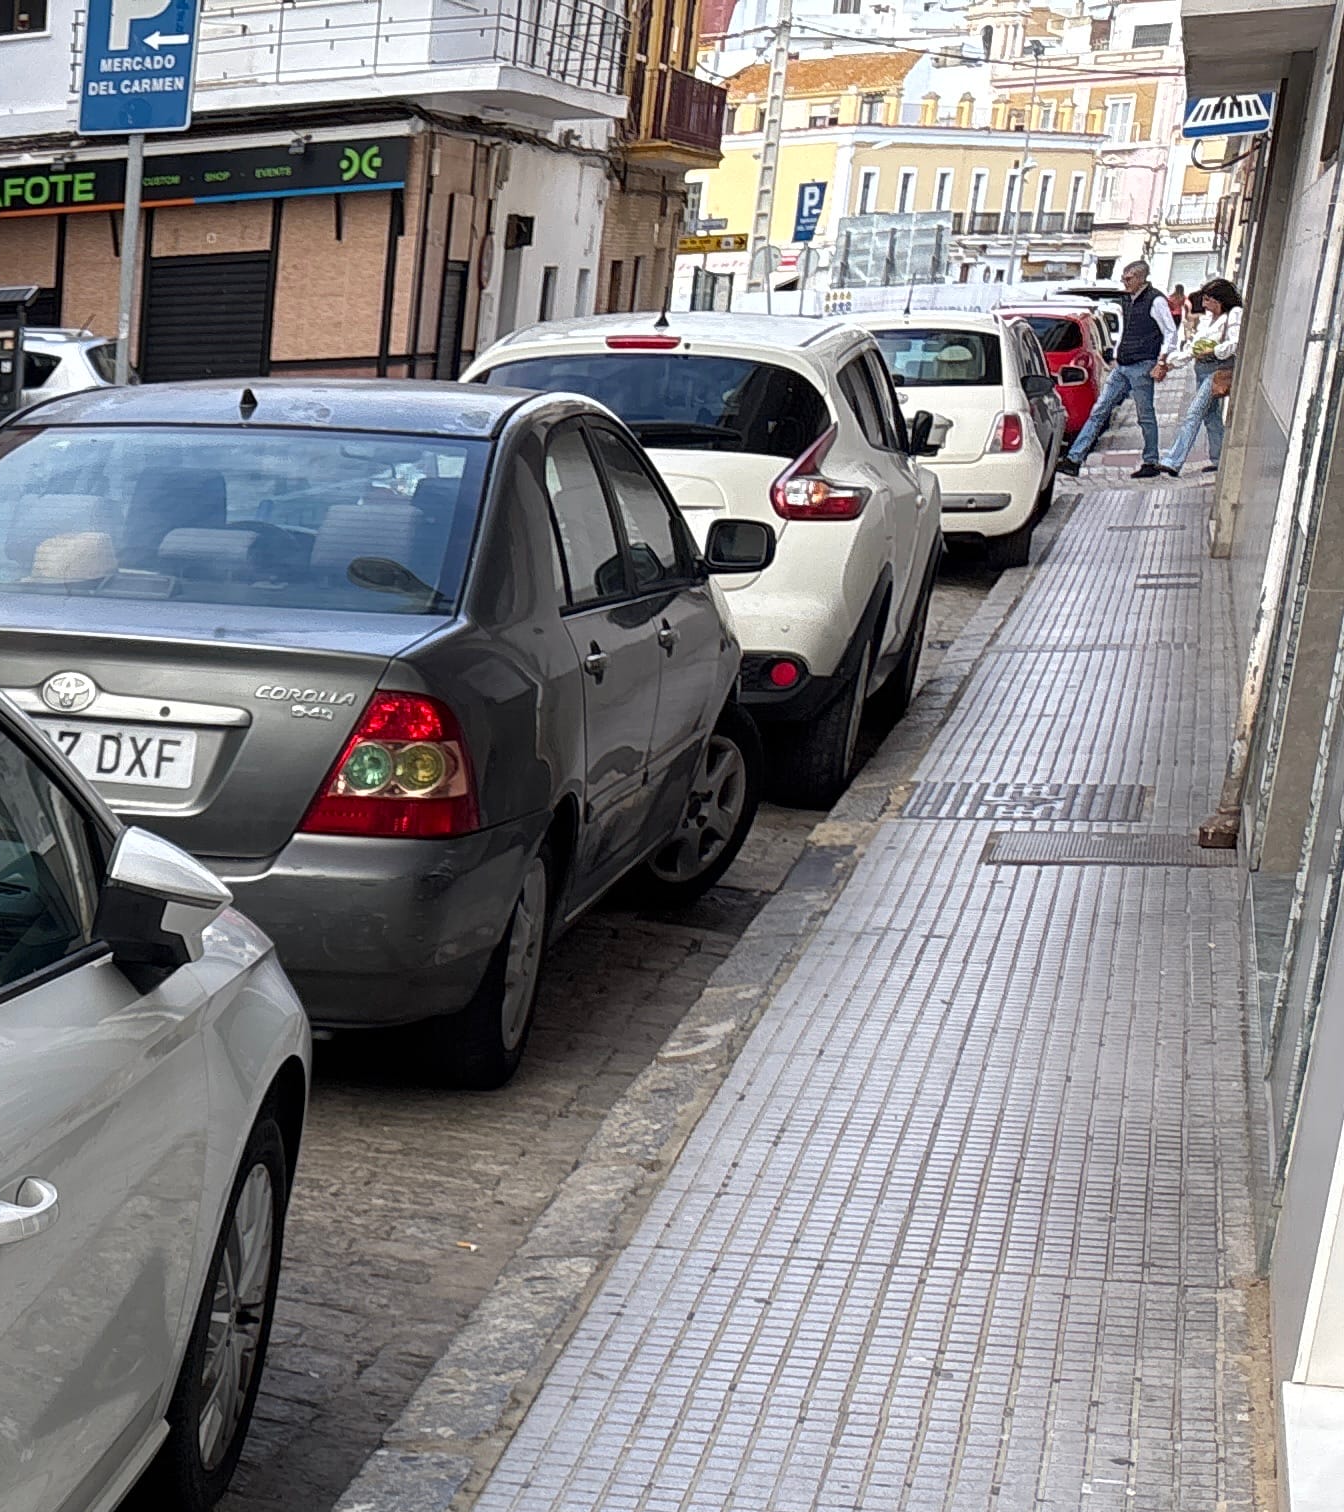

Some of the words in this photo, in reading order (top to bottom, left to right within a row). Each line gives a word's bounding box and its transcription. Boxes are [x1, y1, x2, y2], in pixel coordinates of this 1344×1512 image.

[99, 54, 176, 73] MERCADO
[87, 81, 117, 96] DEL
[120, 76, 185, 94] CARMEN
[802, 186, 821, 218] P
[255, 684, 357, 707] COROLLA
[96, 734, 182, 779] DXF
